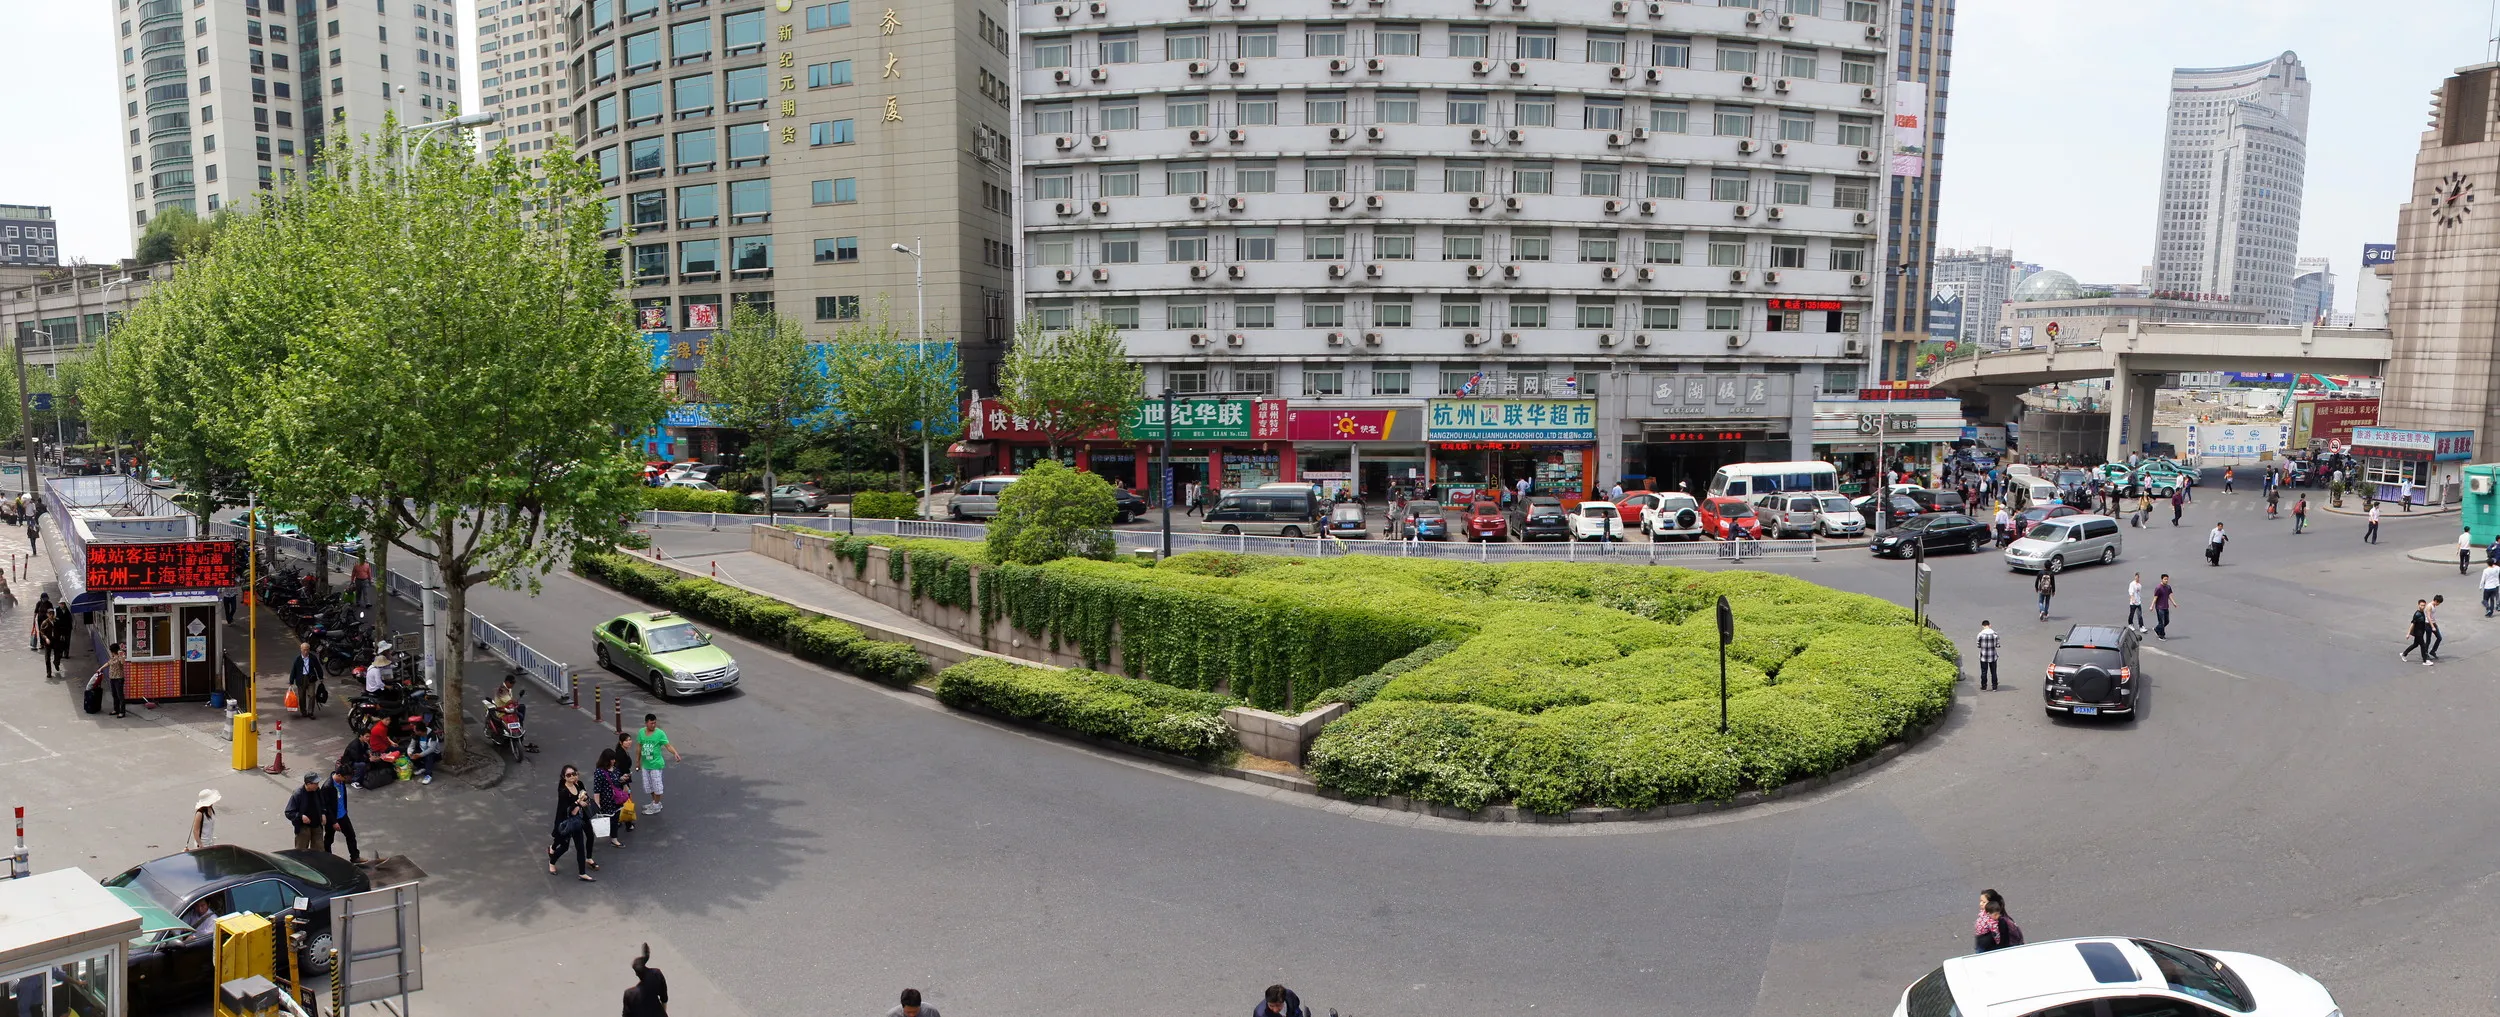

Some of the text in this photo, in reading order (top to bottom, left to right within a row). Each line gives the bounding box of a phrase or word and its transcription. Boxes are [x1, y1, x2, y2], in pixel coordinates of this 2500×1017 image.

[879, 8, 904, 124] 务大厦
[777, 24, 796, 144] 新纪元期货
[2380, 249, 2396, 261] 中
[1480, 376, 1559, 395] 东声网吧
[1655, 381, 1765, 401] 西湖饭店
[1143, 402, 1243, 426] 世纪华联
[1269, 402, 1280, 437] 杭州特产
[1729, 406, 1756, 414] HOTEL
[1360, 424, 1379, 434] 快客
[2356, 429, 2431, 444] 旅游、长途客运售票处
[2437, 438, 2451, 454] 旅游
[2454, 437, 2471, 453] 售票处
[90, 546, 174, 565] 城站客运站
[90, 565, 177, 586] 杭州-上海
[396, 637, 404, 650] P
